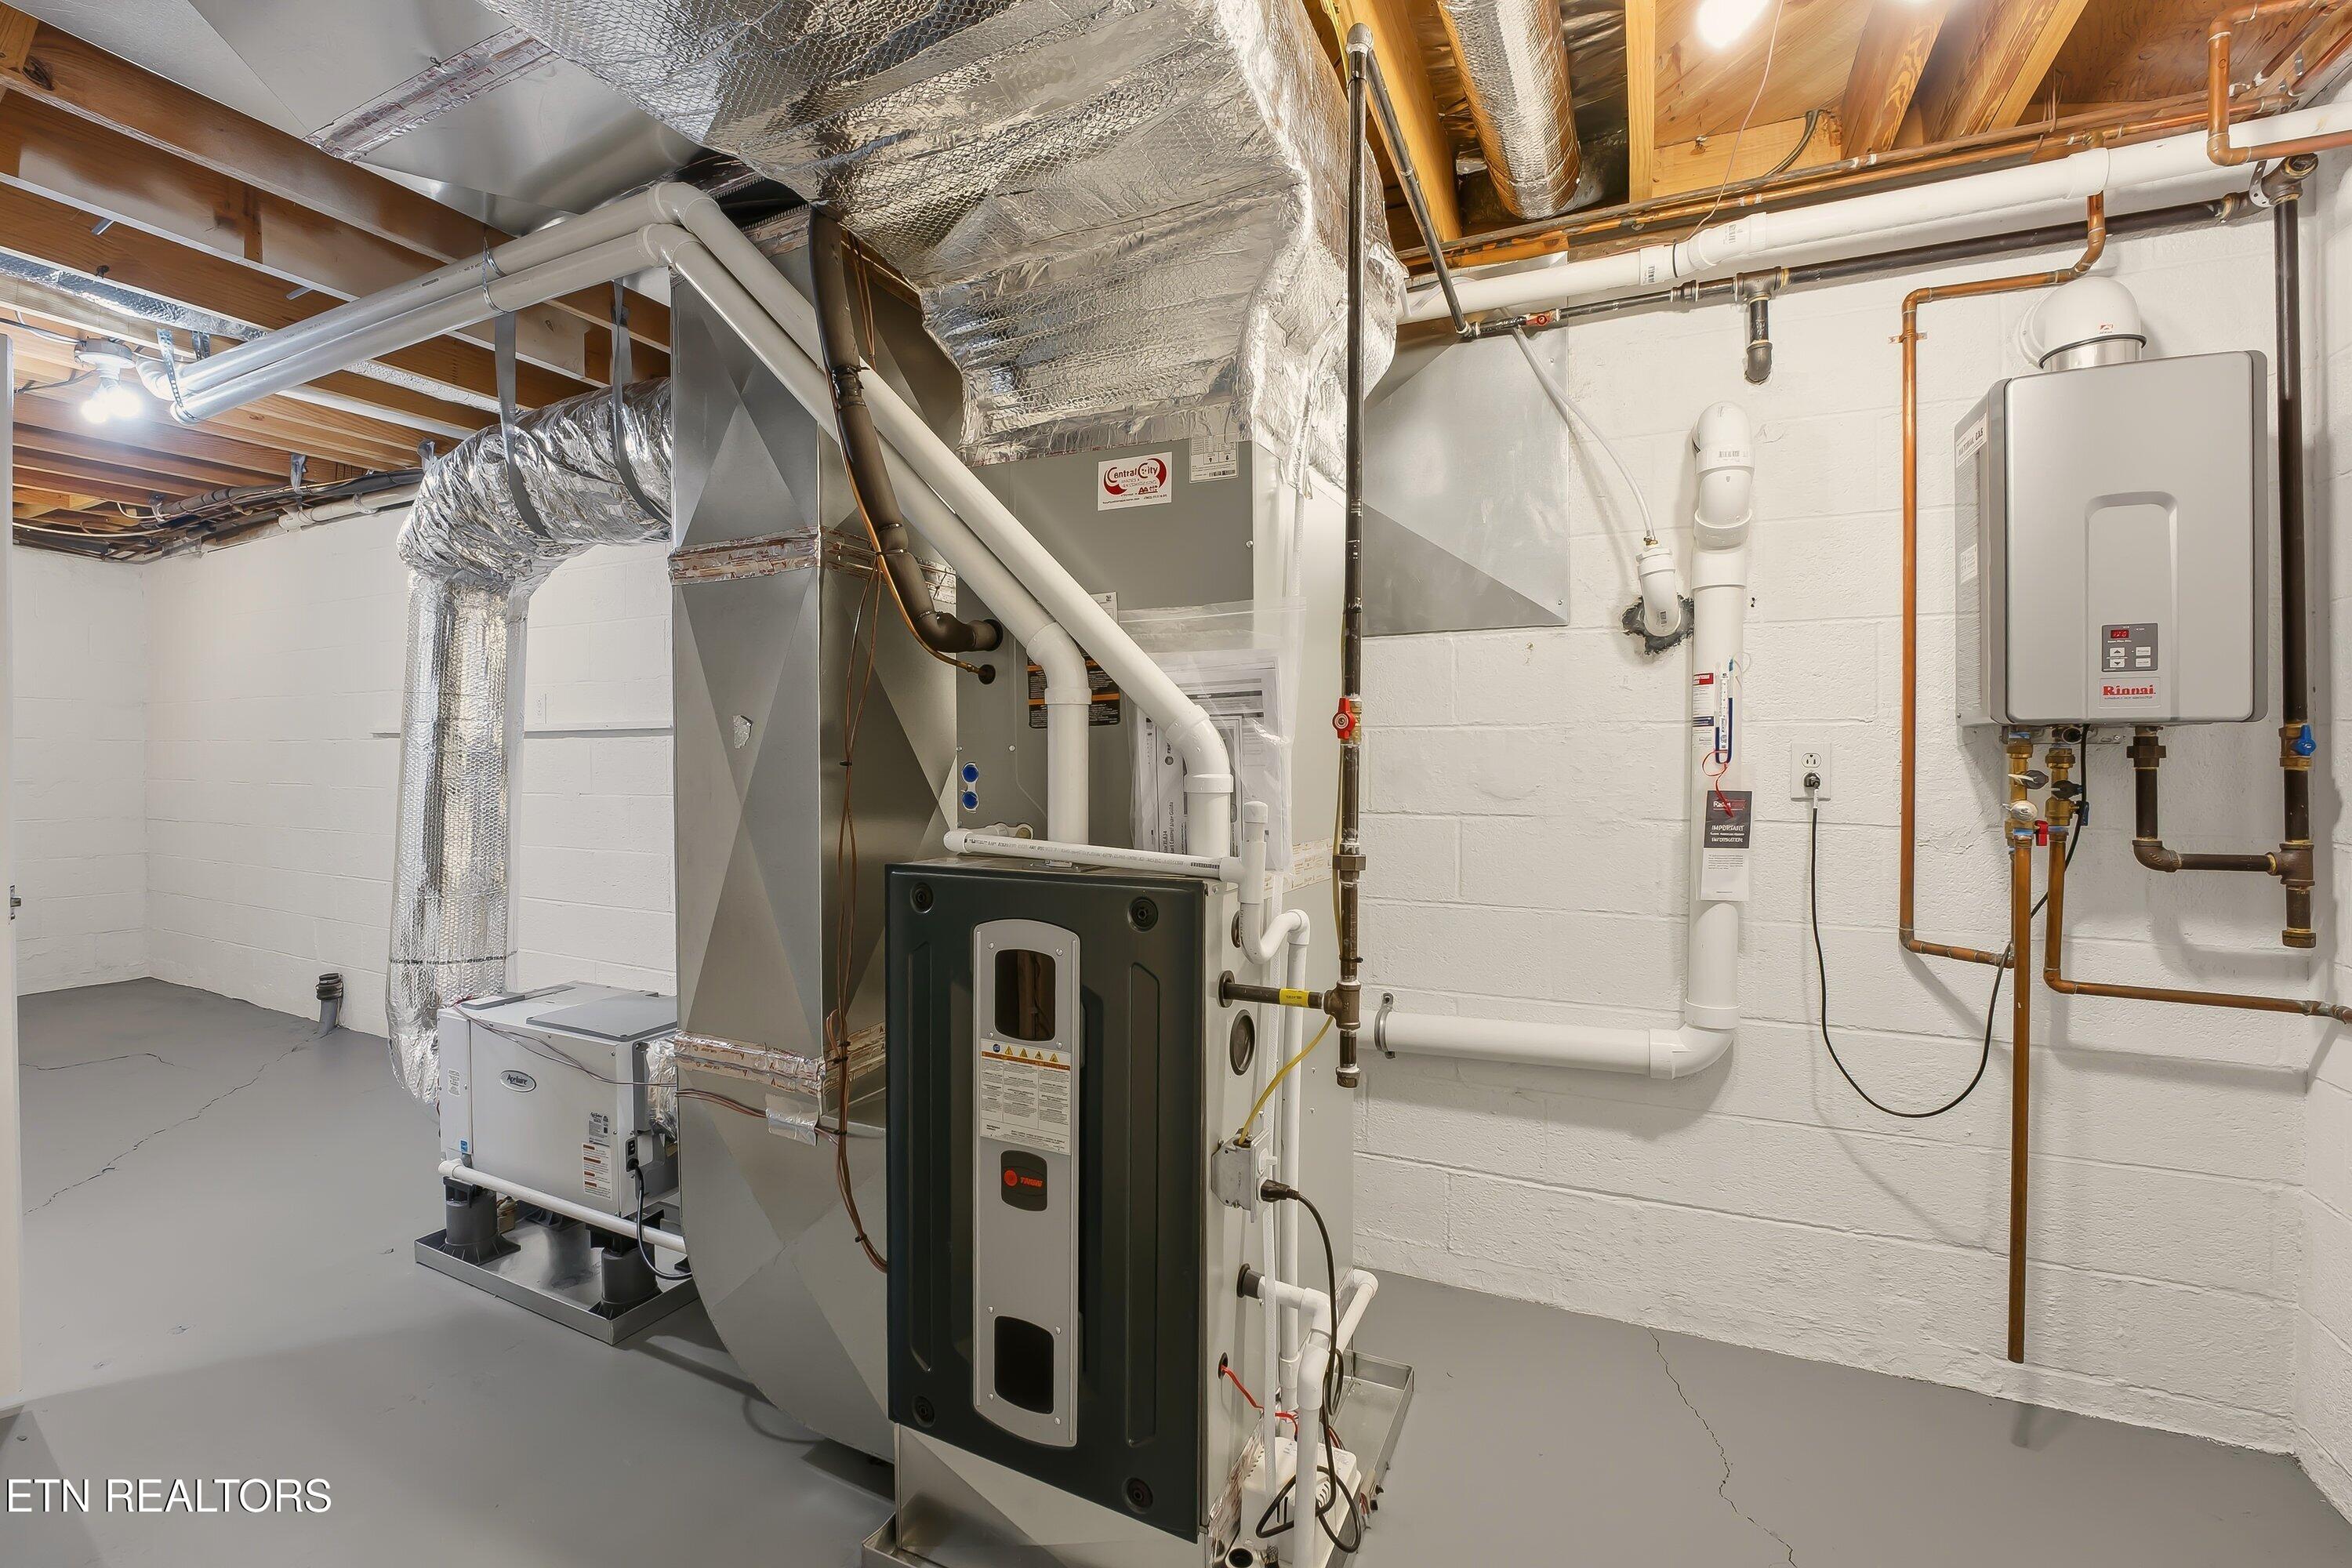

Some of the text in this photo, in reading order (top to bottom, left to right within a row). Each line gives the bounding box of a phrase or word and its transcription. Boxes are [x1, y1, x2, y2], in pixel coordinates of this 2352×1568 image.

[1107, 463, 1159, 483] Central City
[2103, 684, 2154, 696] Rinnai
